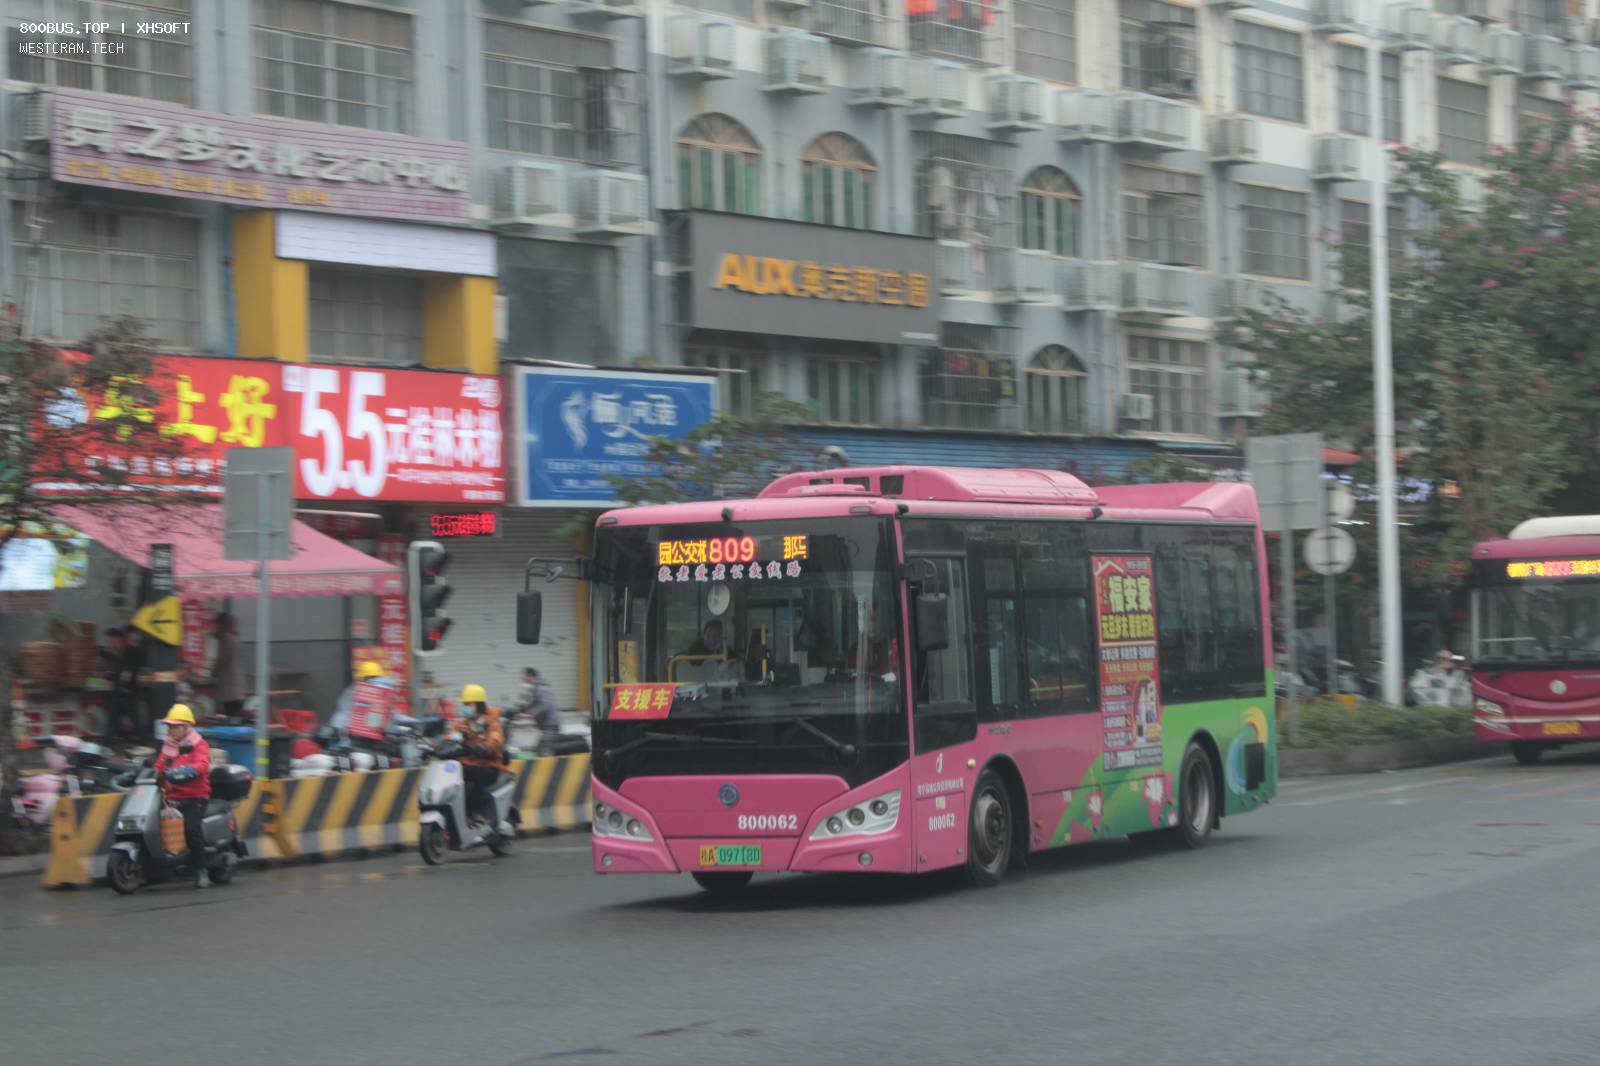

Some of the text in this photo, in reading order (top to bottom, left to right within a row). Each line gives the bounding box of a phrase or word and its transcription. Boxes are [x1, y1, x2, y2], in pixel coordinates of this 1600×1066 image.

[714, 253, 797, 297] AUX
[709, 536, 755, 564] 809
[614, 688, 672, 710] 支援车
[737, 814, 799, 831] 800062
[928, 812, 956, 833] 800062
